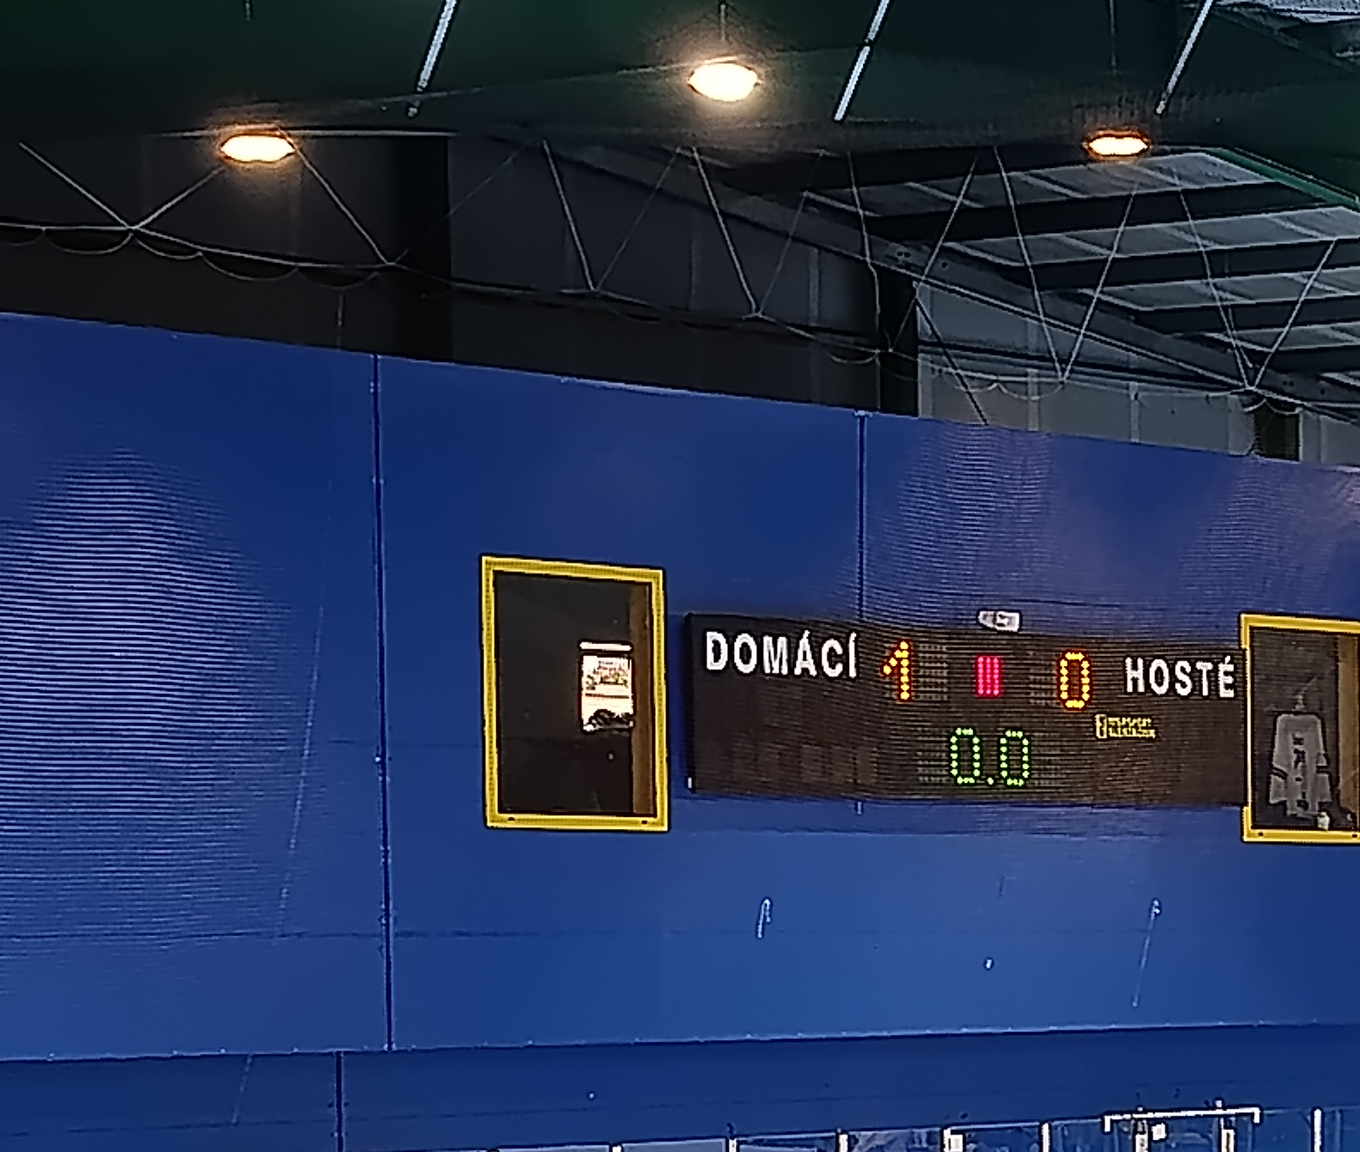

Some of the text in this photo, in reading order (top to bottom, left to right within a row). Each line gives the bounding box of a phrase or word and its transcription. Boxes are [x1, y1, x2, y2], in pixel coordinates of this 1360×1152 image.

[706, 630, 858, 678] DOMÁCÍ
[882, 640, 910, 701] 1
[1058, 651, 1092, 710] 0
[1124, 655, 1235, 698] HOSTÉ
